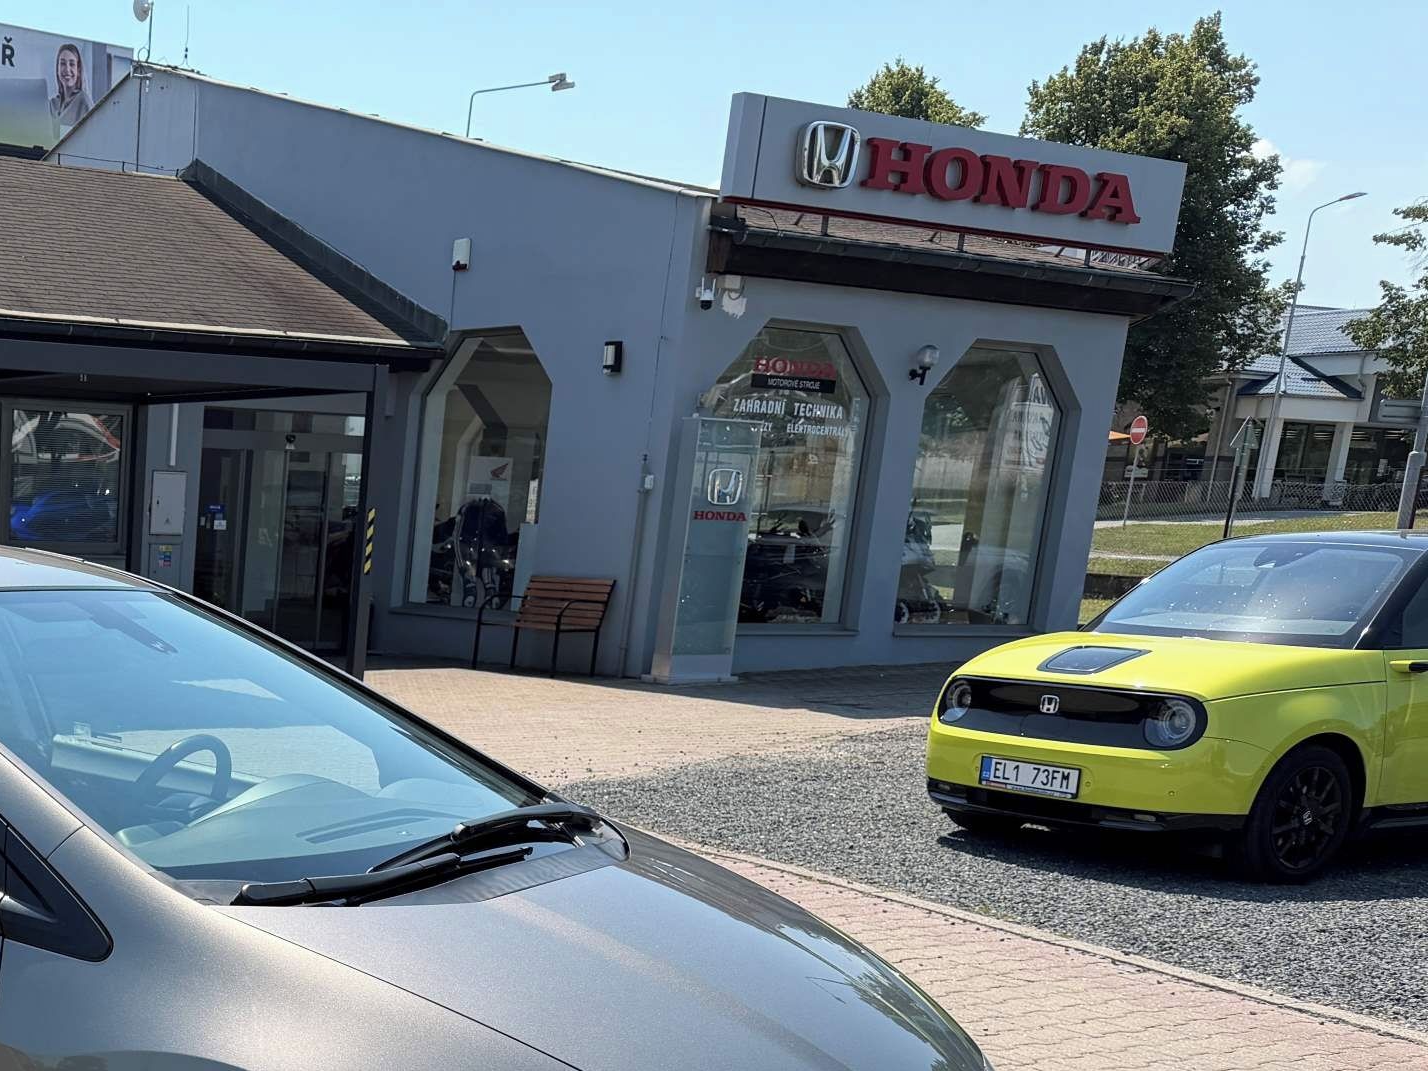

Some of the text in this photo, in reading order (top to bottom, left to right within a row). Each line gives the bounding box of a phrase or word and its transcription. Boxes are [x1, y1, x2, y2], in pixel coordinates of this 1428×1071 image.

[859, 137, 1141, 224] HONDA
[754, 355, 838, 379] HONDA
[733, 398, 843, 419] ZAHRADNÍ TECHNIKA
[693, 511, 747, 521] HONDA
[993, 761, 1071, 789] EL1 73FM
